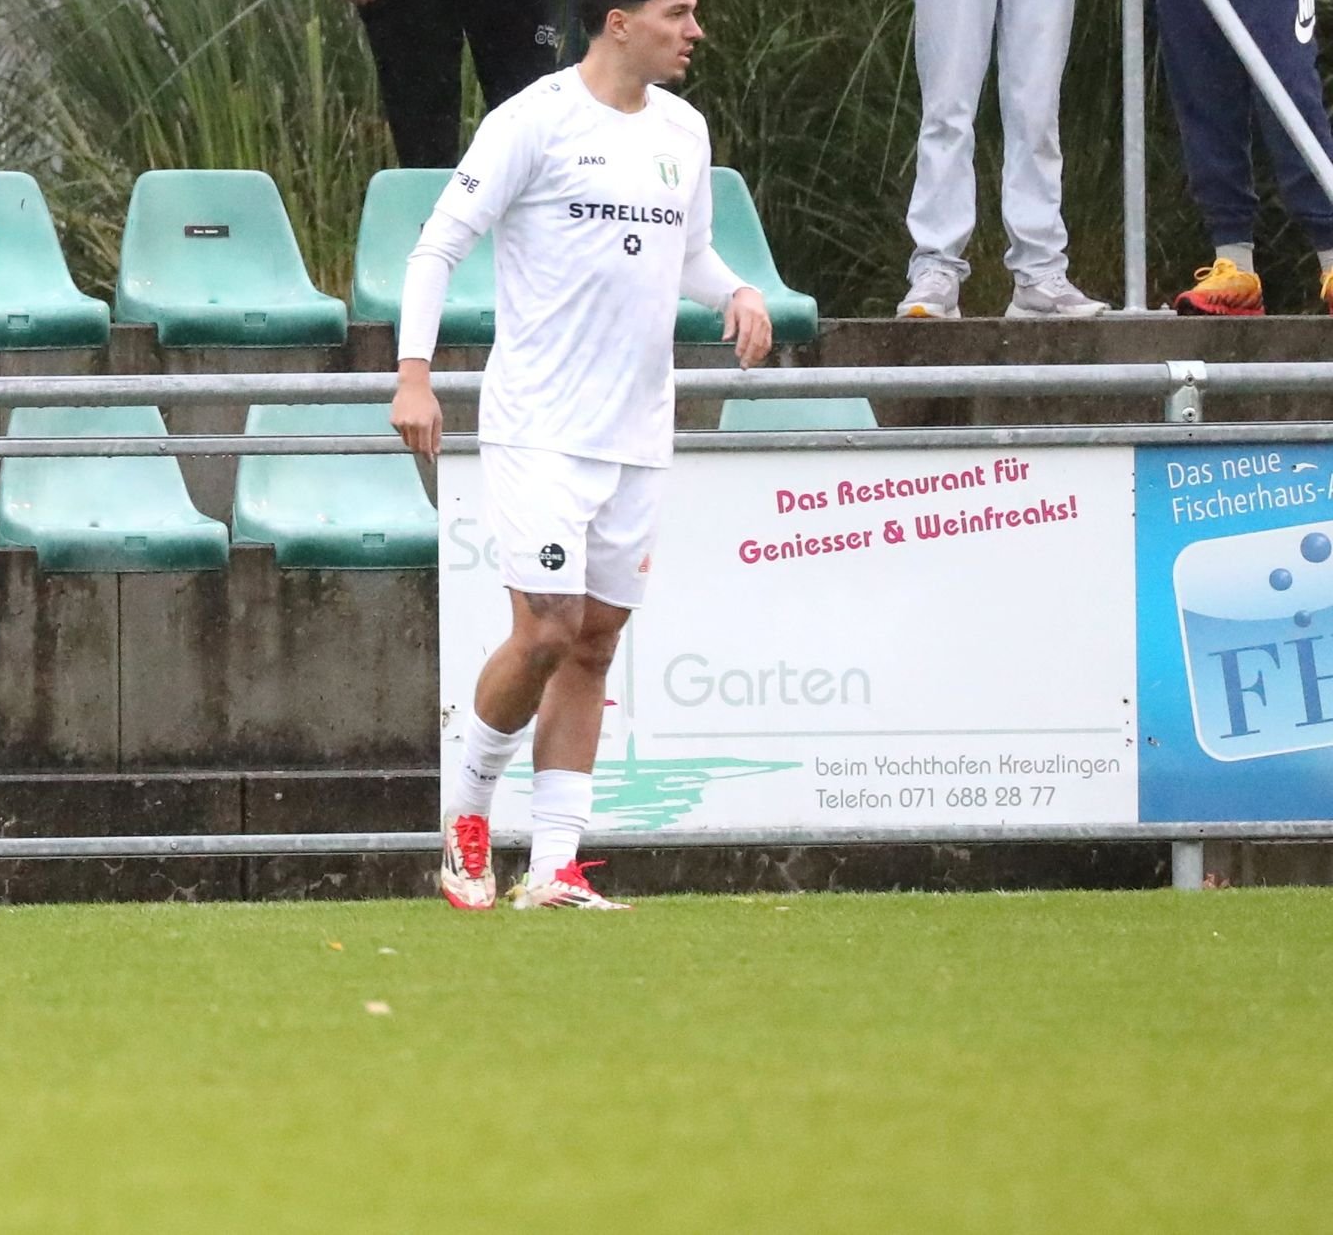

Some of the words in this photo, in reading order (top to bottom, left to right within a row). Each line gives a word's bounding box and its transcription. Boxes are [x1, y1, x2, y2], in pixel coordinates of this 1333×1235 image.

[578, 155, 606, 165] JAKO
[569, 202, 684, 227] STRELLSON
[776, 489, 828, 514] Das
[837, 466, 986, 505] Restaurant
[994, 457, 1030, 483] für
[1167, 461, 1213, 489] Das
[1221, 452, 1282, 480] neue
[1171, 473, 1333, 524] Fischerhaus-
[739, 530, 873, 564] Geniesser
[883, 520, 906, 544] &
[915, 495, 1078, 540] Weinfreaks!
[663, 653, 871, 707] Garten
[815, 756, 867, 776] beim
[874, 754, 991, 776] Yachthafen
[999, 753, 1120, 779] Kreuzlingen
[815, 788, 892, 809] Telefon
[899, 787, 934, 808] 071
[945, 786, 988, 808] 688
[995, 786, 1022, 807] 28
[1030, 786, 1056, 807] 77
